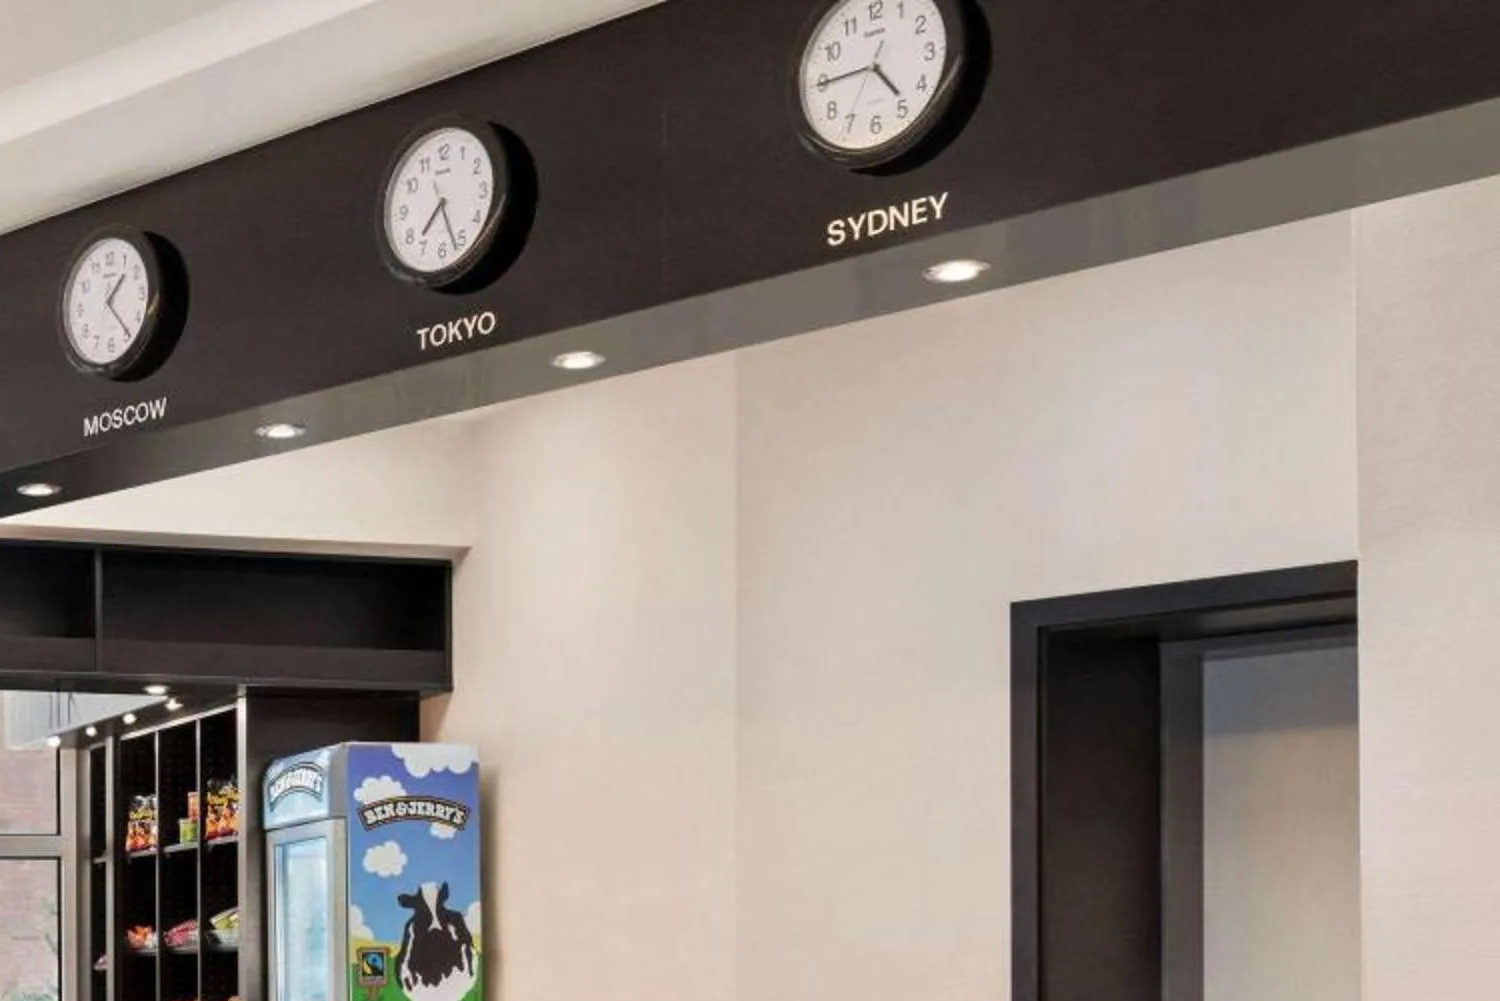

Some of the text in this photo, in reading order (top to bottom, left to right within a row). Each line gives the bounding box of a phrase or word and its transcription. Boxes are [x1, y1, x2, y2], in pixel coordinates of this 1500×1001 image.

[867, 0, 884, 20] 12
[897, 3, 904, 19] 1
[843, 16, 857, 37] 11
[915, 15, 927, 35] 2
[824, 41, 841, 62] 10
[924, 41, 936, 62] 3
[817, 73, 829, 92] 9
[916, 73, 927, 92] 4
[826, 101, 837, 120] 8
[896, 100, 908, 119] 5
[845, 113, 856, 134] 7
[870, 115, 882, 135] 6
[827, 192, 949, 246] SYDNEY
[416, 311, 497, 351] TOKYO
[83, 396, 167, 437] MOSCOW
